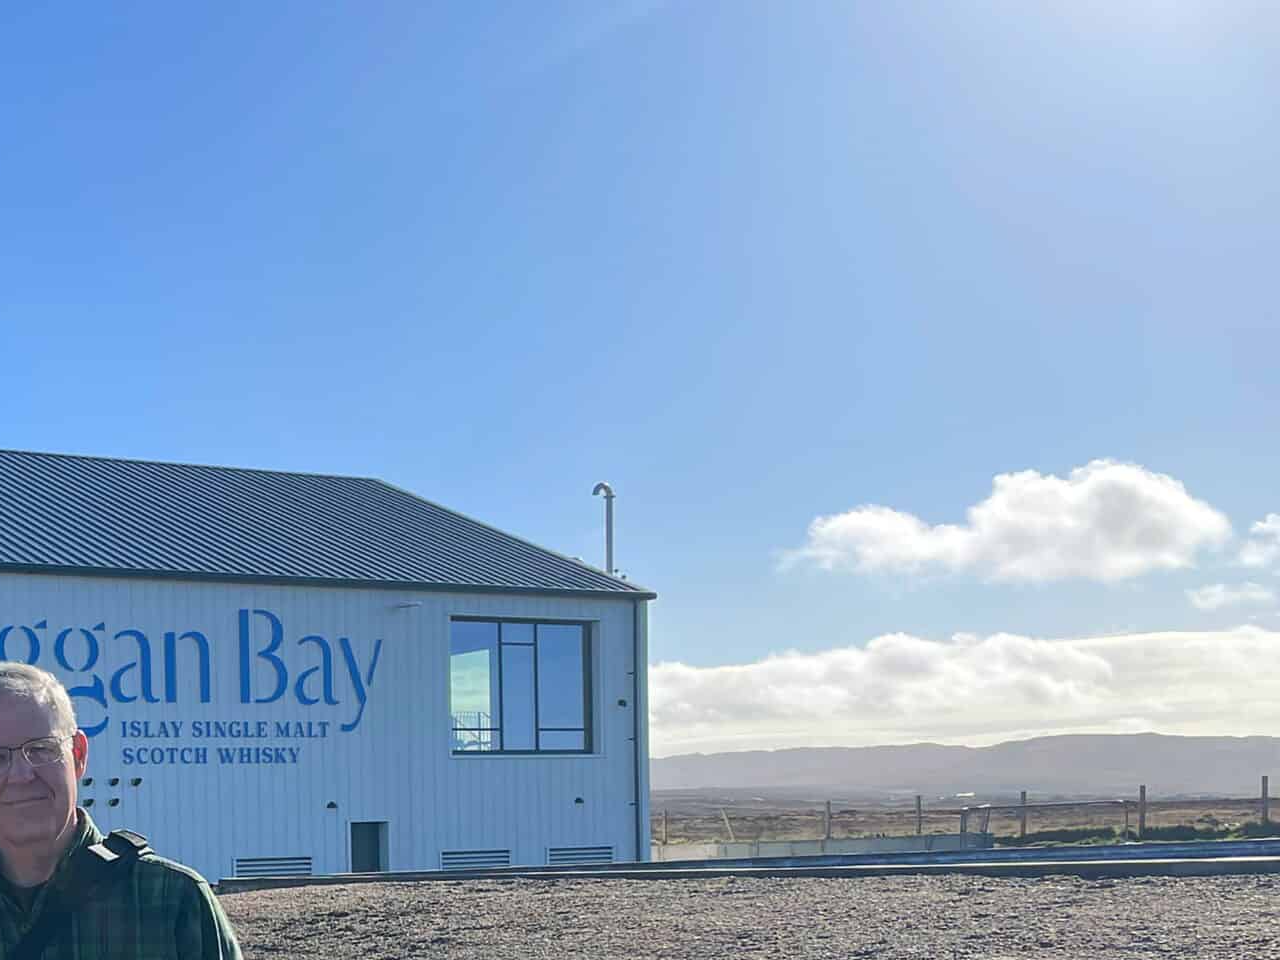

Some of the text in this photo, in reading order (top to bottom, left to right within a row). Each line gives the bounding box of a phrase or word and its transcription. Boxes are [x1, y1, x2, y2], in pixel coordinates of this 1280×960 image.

[238, 608, 383, 733] Bay
[121, 720, 330, 738] ISLAY SINGLE MALT
[122, 747, 301, 765] SCOTCH WHISKY
